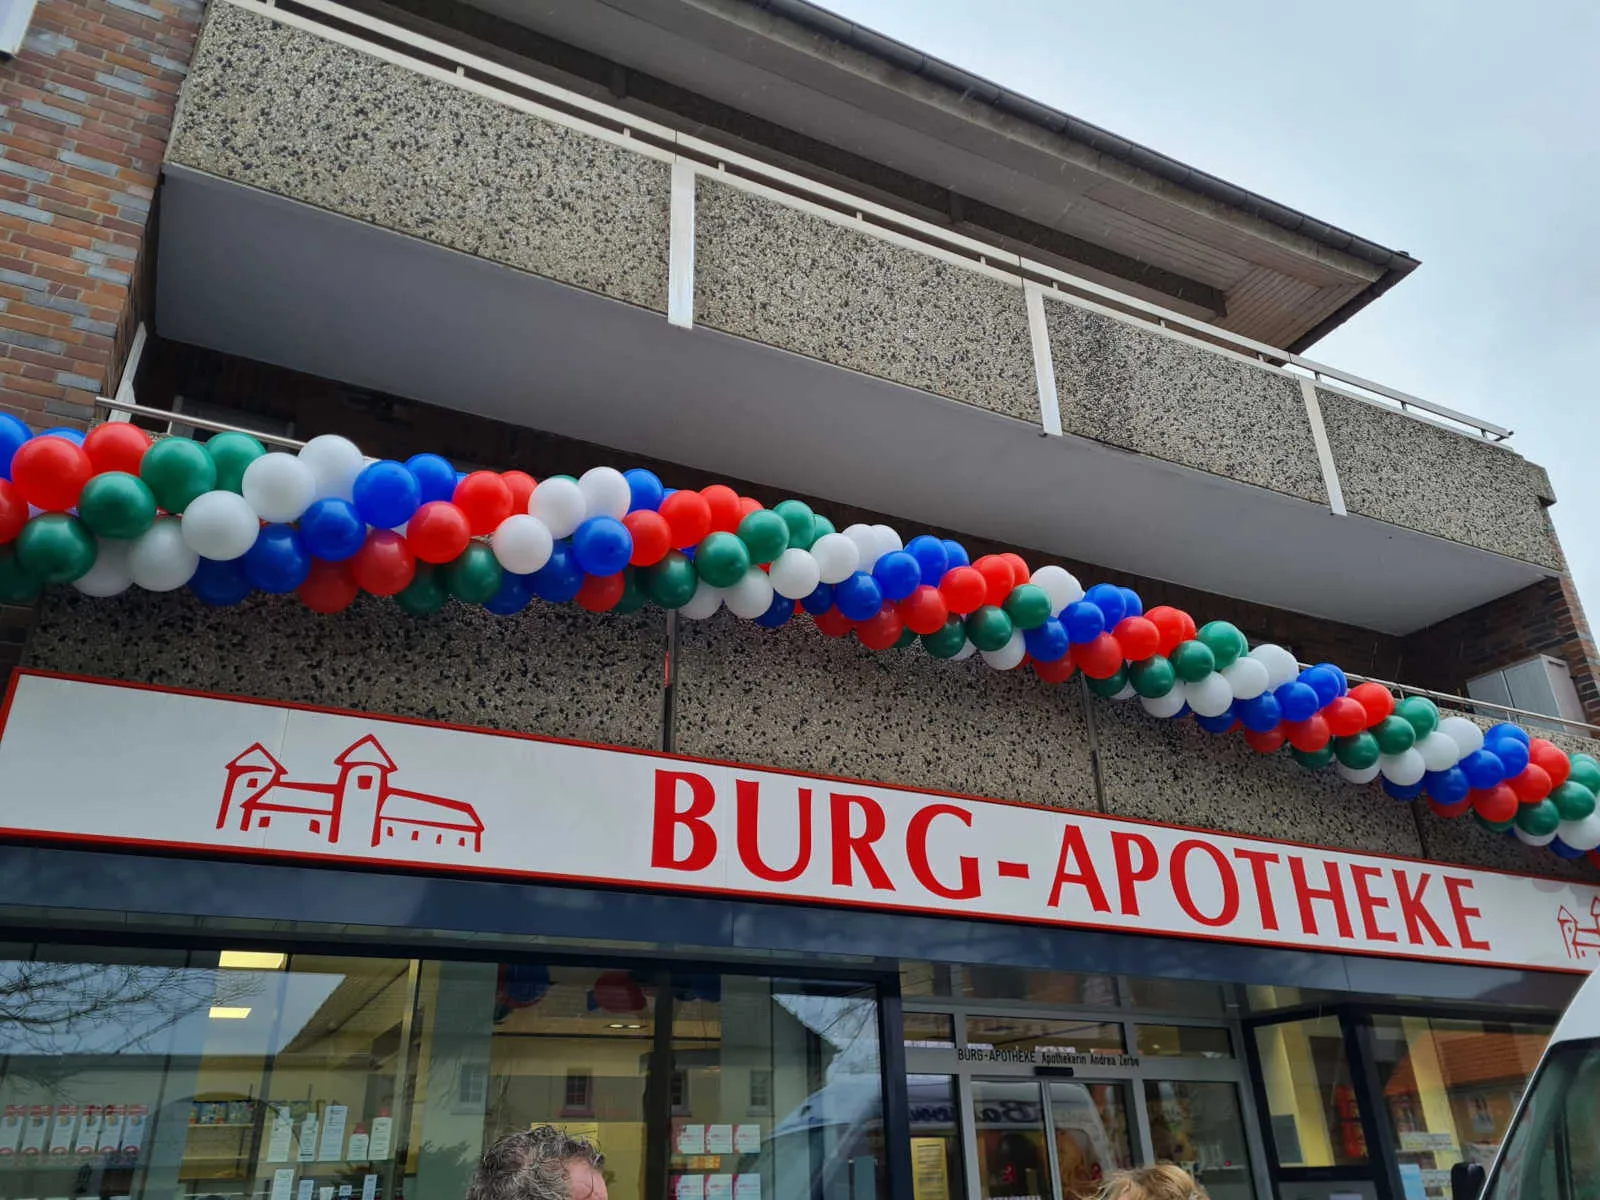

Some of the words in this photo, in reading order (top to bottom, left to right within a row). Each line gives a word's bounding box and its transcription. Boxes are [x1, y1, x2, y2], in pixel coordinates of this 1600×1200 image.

[652, 769, 1490, 950] BURG-APOTHEKE
[957, 1048, 1036, 1064] BURG-APOTHEKE
[1041, 1052, 1087, 1066] Apothekerin
[1090, 1053, 1117, 1067] Andrea
